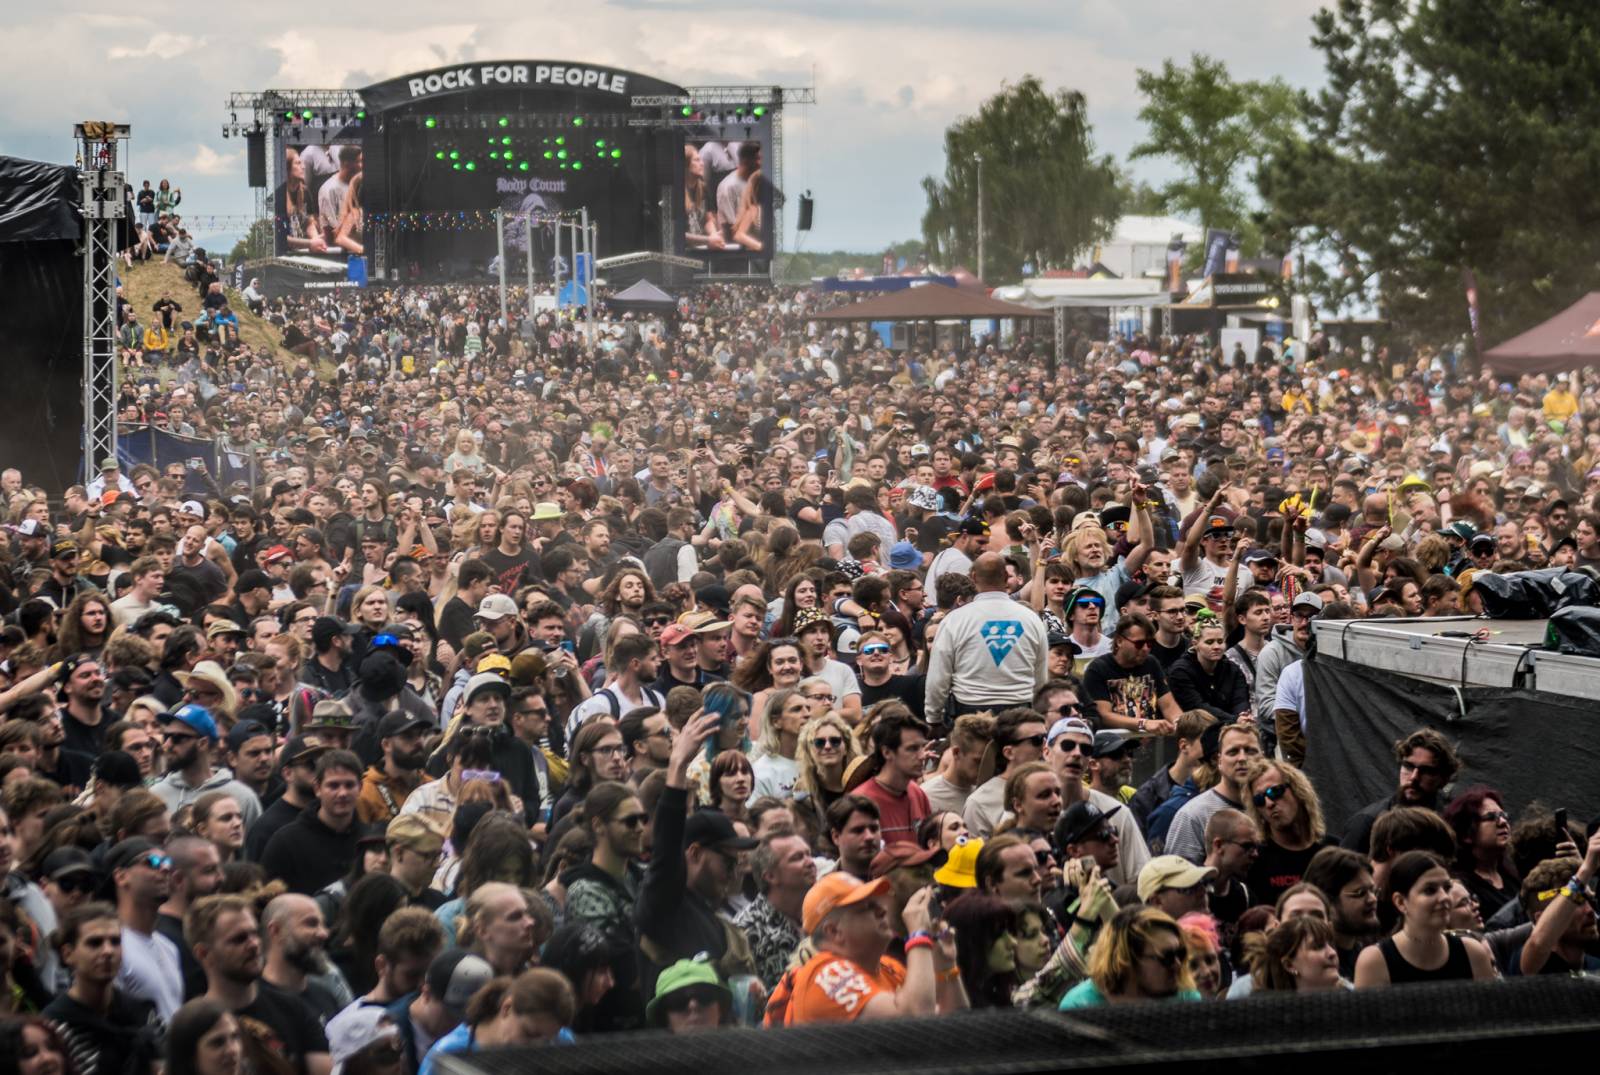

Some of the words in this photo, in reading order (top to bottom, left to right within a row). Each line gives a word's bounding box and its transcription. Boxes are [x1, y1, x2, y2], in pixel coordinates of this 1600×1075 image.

[408, 68, 474, 96] ROCK
[481, 65, 528, 85] FOR
[535, 65, 627, 93] PEOPLE
[496, 177, 526, 194] Body
[529, 177, 566, 193] Count
